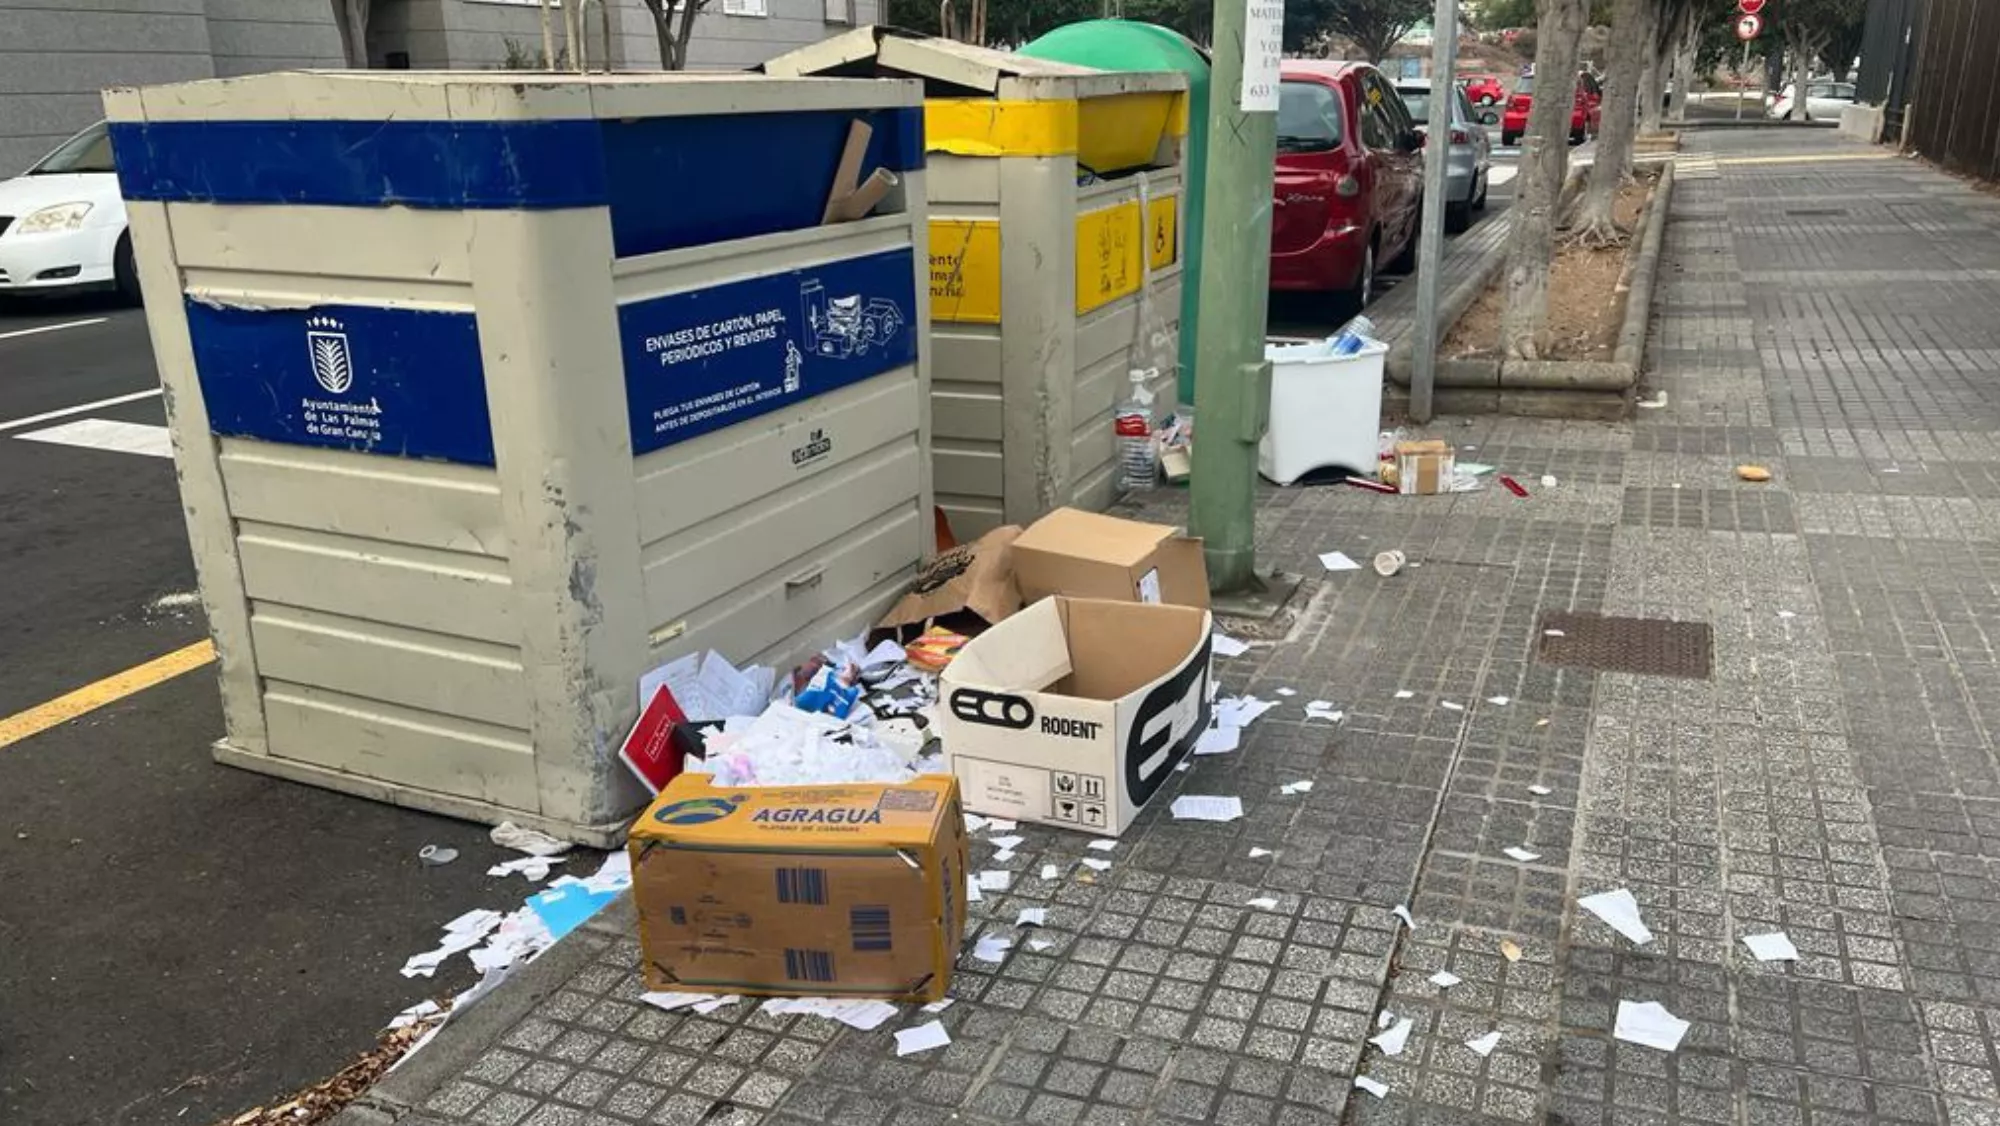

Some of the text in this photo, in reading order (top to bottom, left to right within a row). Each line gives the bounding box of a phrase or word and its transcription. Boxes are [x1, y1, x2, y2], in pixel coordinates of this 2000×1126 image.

[646, 329, 694, 352] ENVASES
[696, 325, 711, 340] DE
[755, 308, 786, 325] PAPEL,
[661, 325, 777, 366] PERIÓDICOS Y REVISTAS
[302, 398, 379, 415] Ayuntamiento
[304, 410, 380, 428] de Las Palmas
[654, 406, 680, 420] PLIEGA
[681, 402, 694, 412] TUS
[695, 392, 724, 408] ENVASES
[725, 389, 735, 399] DE
[656, 419, 679, 433] ANTES
[680, 415, 689, 426] DE
[737, 398, 747, 408] EN
[306, 422, 319, 435] de
[320, 423, 345, 437] Gran
[950, 688, 1035, 730] ECO
[752, 808, 882, 824] AGRAGUA
